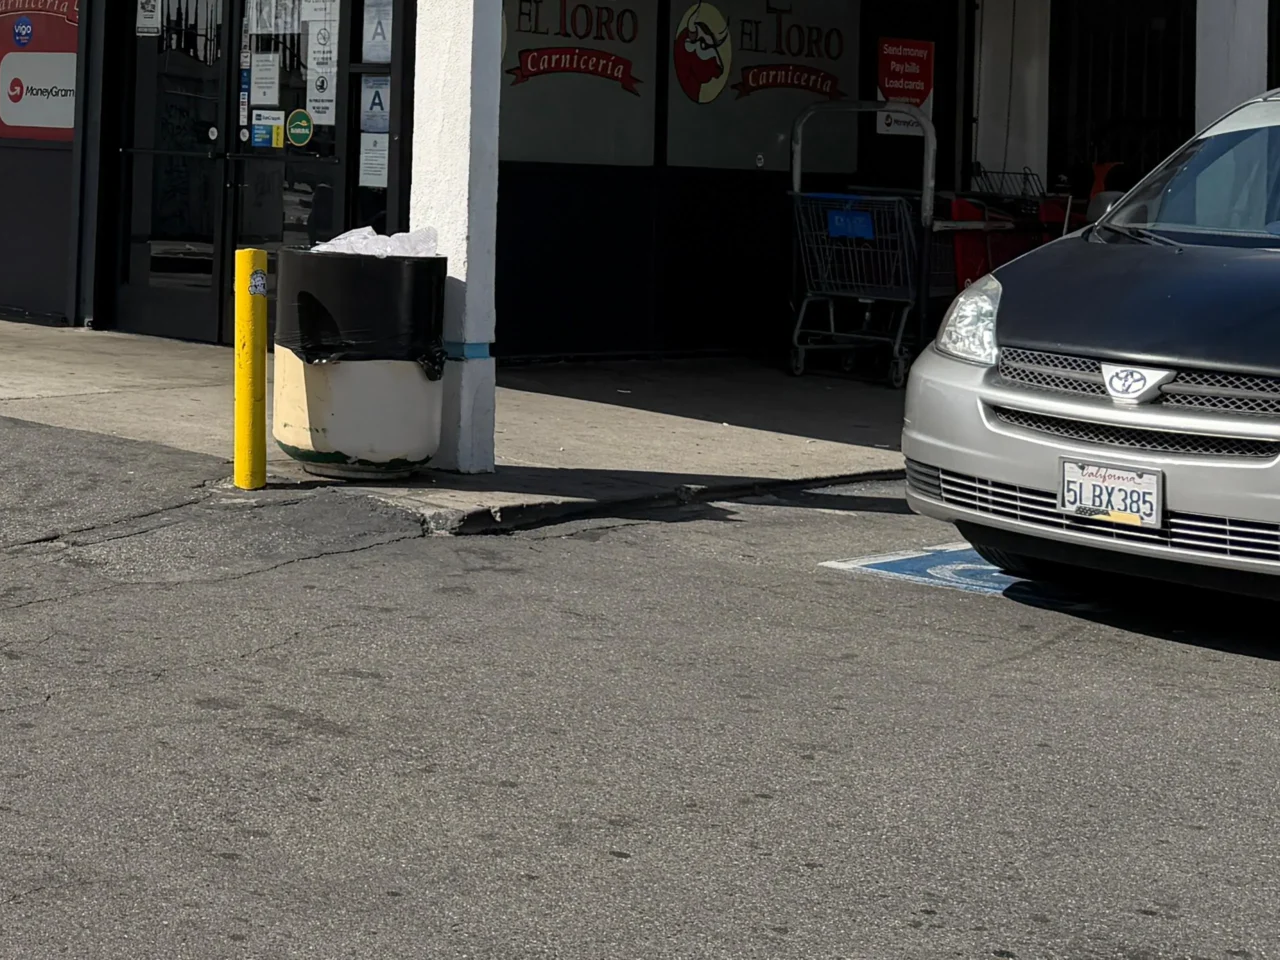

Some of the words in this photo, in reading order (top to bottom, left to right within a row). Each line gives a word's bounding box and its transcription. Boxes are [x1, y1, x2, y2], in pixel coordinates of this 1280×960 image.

[14, 22, 32, 35] vigo
[371, 20, 386, 41] A
[738, 19, 767, 53] EL
[883, 44, 902, 56] Send
[903, 48, 928, 61] money
[890, 61, 904, 74] Pay
[905, 62, 920, 74] bills
[25, 86, 75, 98] MoneyGram
[885, 77, 903, 88] Load
[904, 80, 925, 90] cards
[369, 90, 384, 111] A
[1081, 465, 1142, 485] California
[1066, 480, 1154, 518] 5LBX385
